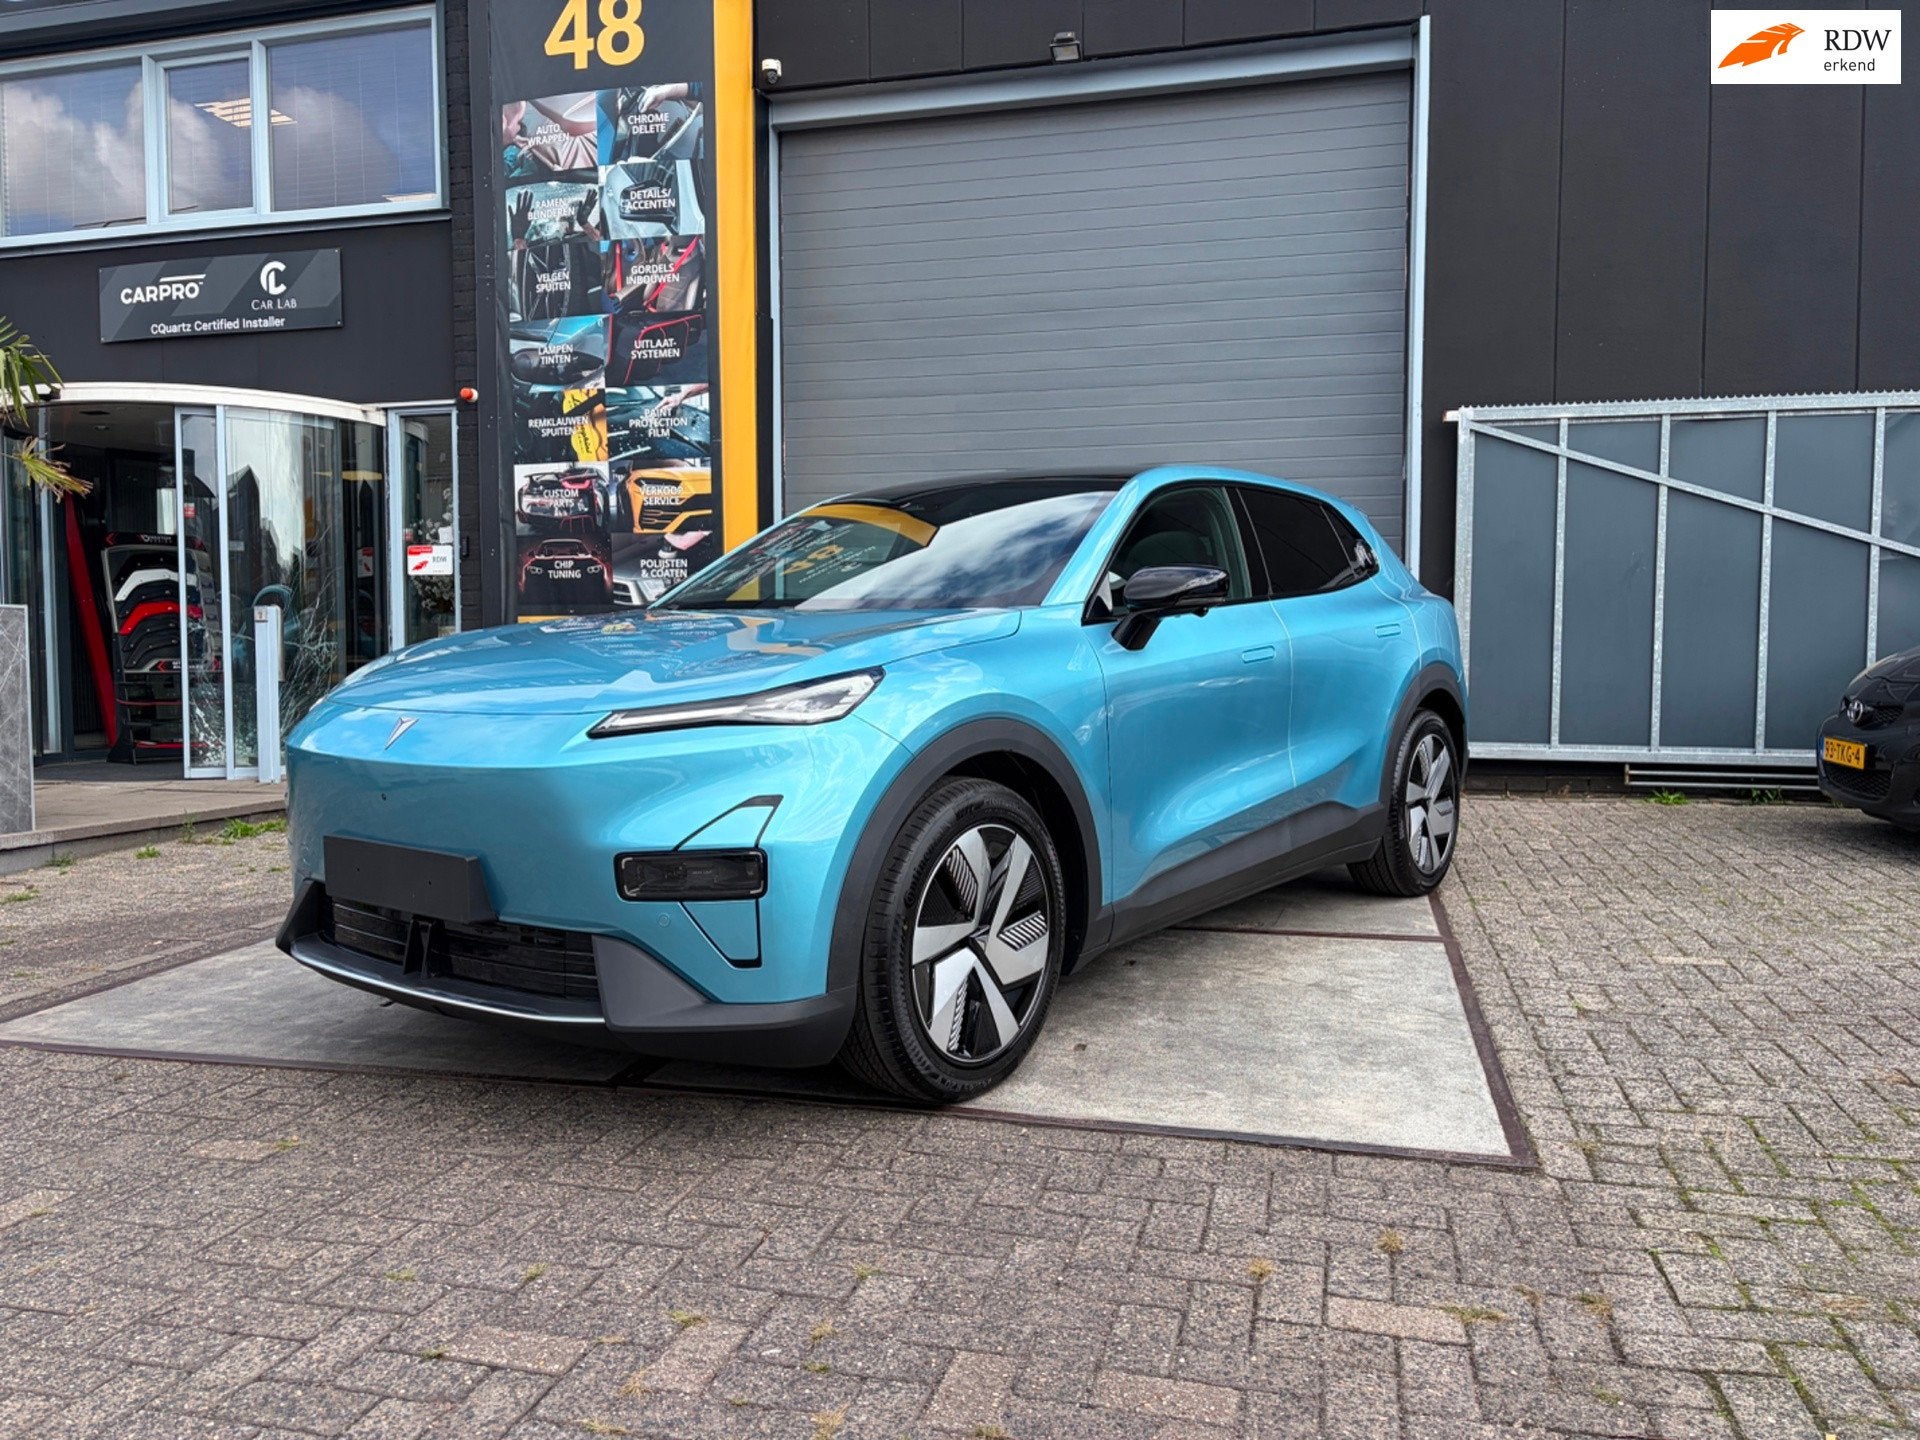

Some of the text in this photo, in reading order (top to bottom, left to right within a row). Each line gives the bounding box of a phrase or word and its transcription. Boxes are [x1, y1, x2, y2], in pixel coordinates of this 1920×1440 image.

[544, 0, 645, 70] 48
[627, 113, 670, 125] CHROME
[535, 124, 561, 135] AUTO
[632, 123, 667, 134] DELETE
[528, 133, 570, 147] WRAPPEN
[630, 187, 672, 200] DETAILS/
[626, 198, 676, 211] ACCENTEN
[527, 207, 575, 221] BLINDEREN
[631, 263, 676, 276] GORDELS
[536, 271, 571, 283] VELGEN
[626, 273, 681, 285] INBOUWEN
[120, 281, 201, 305] CARPRO
[535, 281, 572, 293] SPUITEN
[251, 298, 298, 311] CAR LAB
[150, 315, 286, 335] CQuartz Certified Installer
[538, 344, 574, 355] LAMPEN
[634, 338, 677, 350] UITLAAT-
[540, 354, 572, 366] TINTEN
[630, 348, 681, 360] SYSTEMEN
[643, 408, 673, 419] PAINT
[528, 416, 590, 429] REMKLAUWEN
[628, 417, 688, 429] PROTECTION
[541, 427, 577, 438] SPUITEN
[648, 427, 671, 438] FILM
[542, 489, 579, 499] CUSTOM
[640, 486, 684, 497] VERKOOP
[643, 496, 680, 506] SERVICE
[554, 560, 575, 570] CHIP
[640, 559, 688, 569] POLIJSTEN
[547, 569, 582, 580] TUNING
[641, 567, 688, 579] & COATEN
